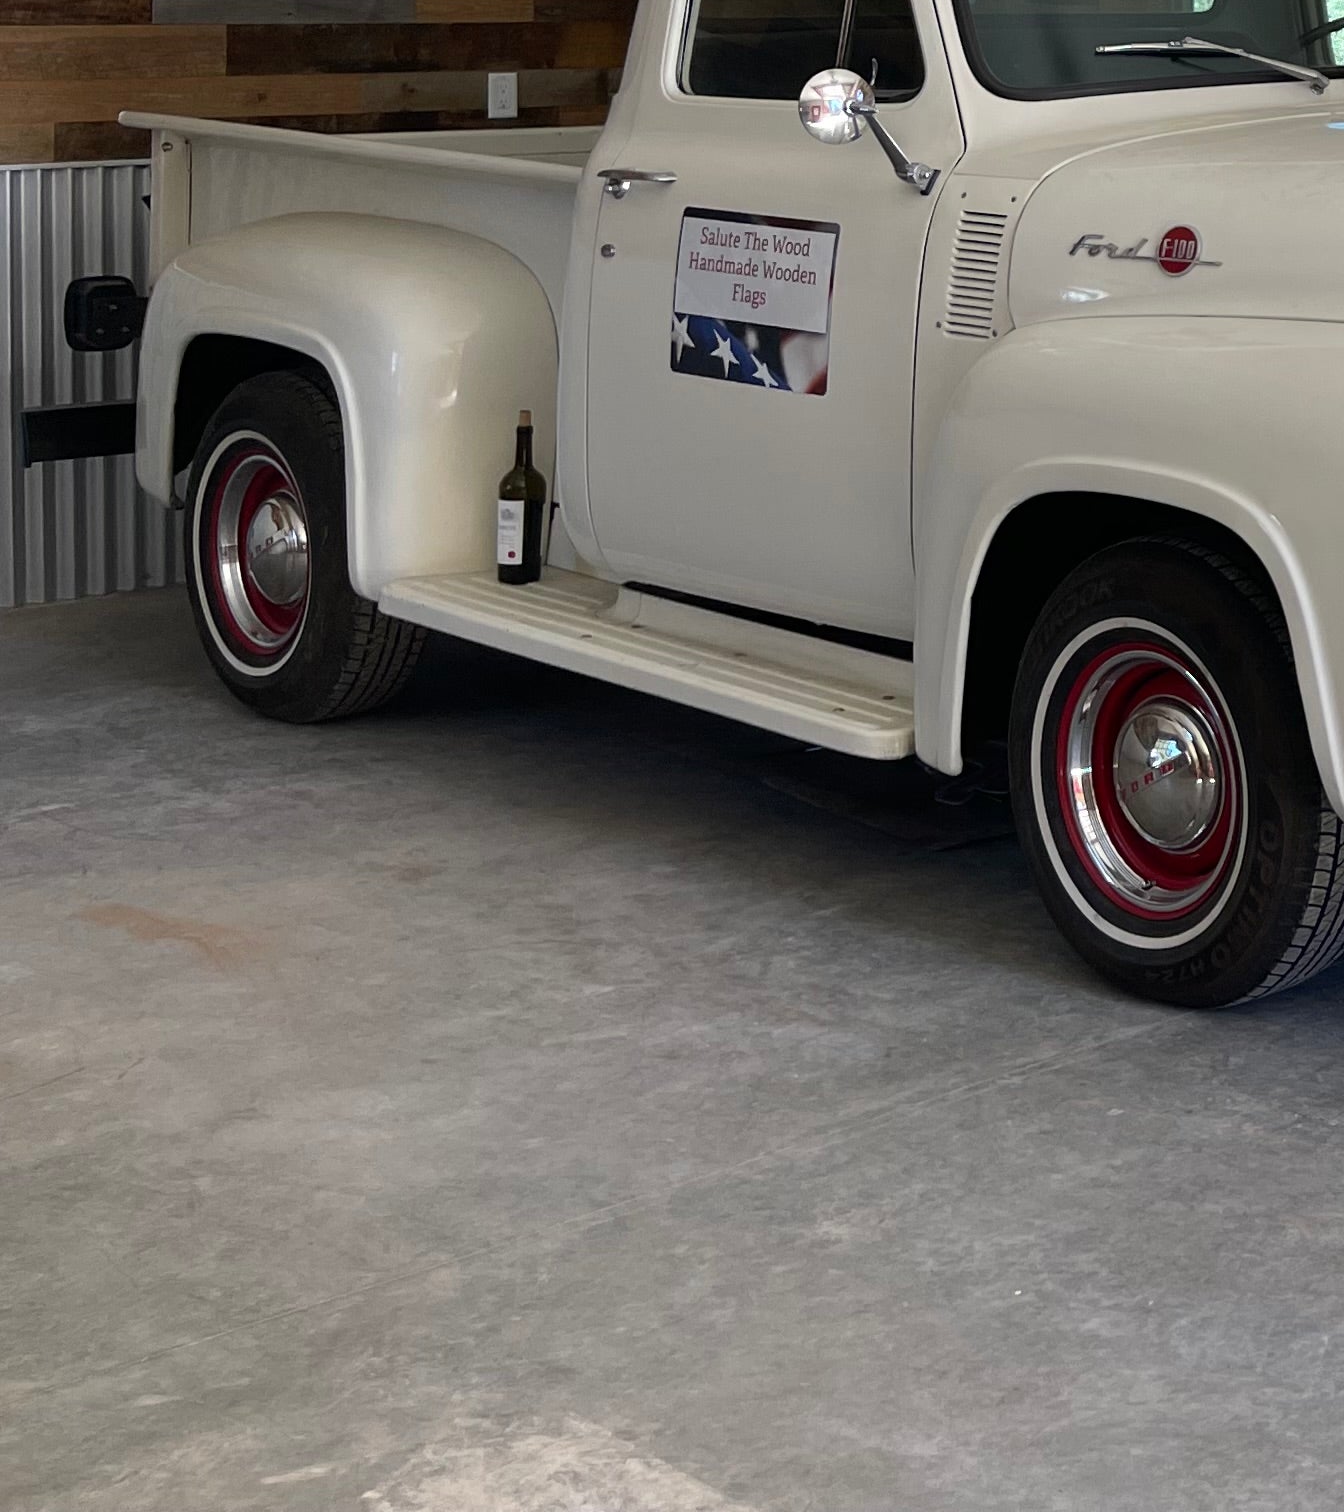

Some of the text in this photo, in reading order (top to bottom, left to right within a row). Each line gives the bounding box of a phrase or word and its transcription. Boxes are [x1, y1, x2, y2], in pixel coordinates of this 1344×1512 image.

[700, 226, 811, 257] Salute The Wood
[1069, 234, 1195, 259] Ford F-100
[688, 251, 817, 286] Handmade Wooden
[732, 283, 767, 309] Flags
